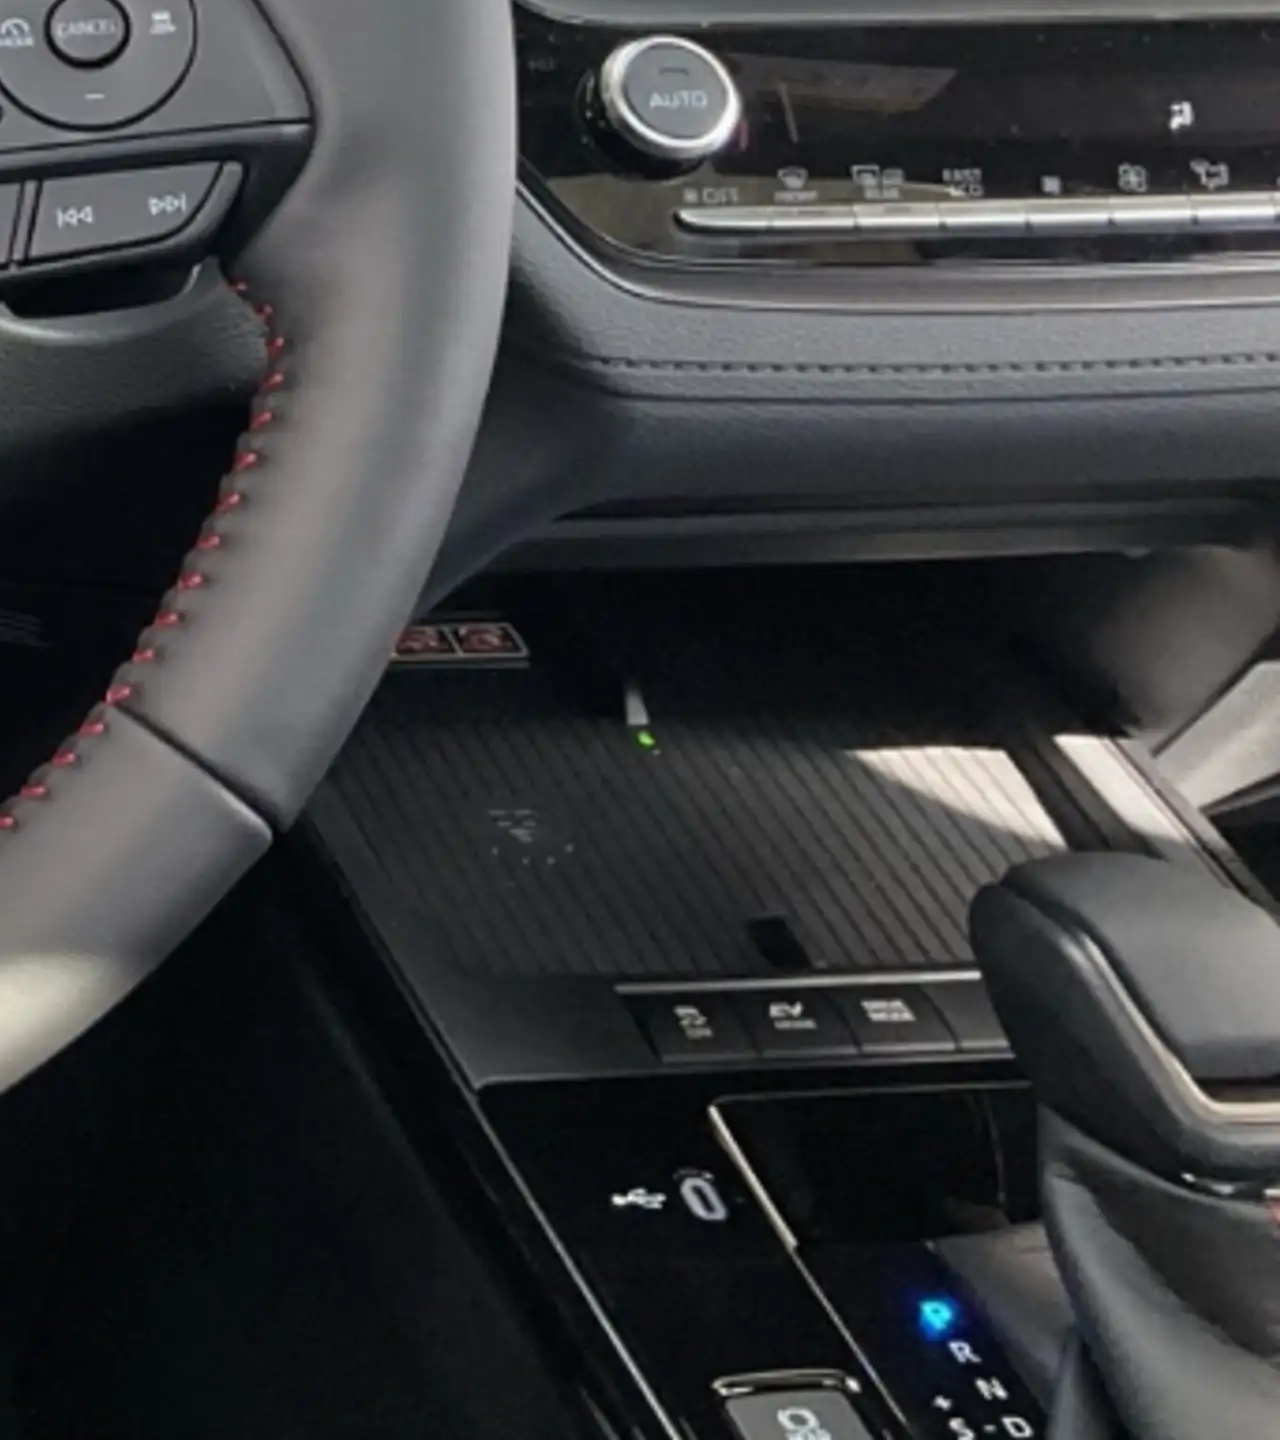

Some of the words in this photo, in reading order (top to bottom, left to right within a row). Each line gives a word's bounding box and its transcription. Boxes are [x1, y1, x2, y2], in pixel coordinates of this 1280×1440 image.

[649, 90, 708, 111] AUTO
[948, 1340, 982, 1363] R
[974, 1376, 1009, 1401] N
